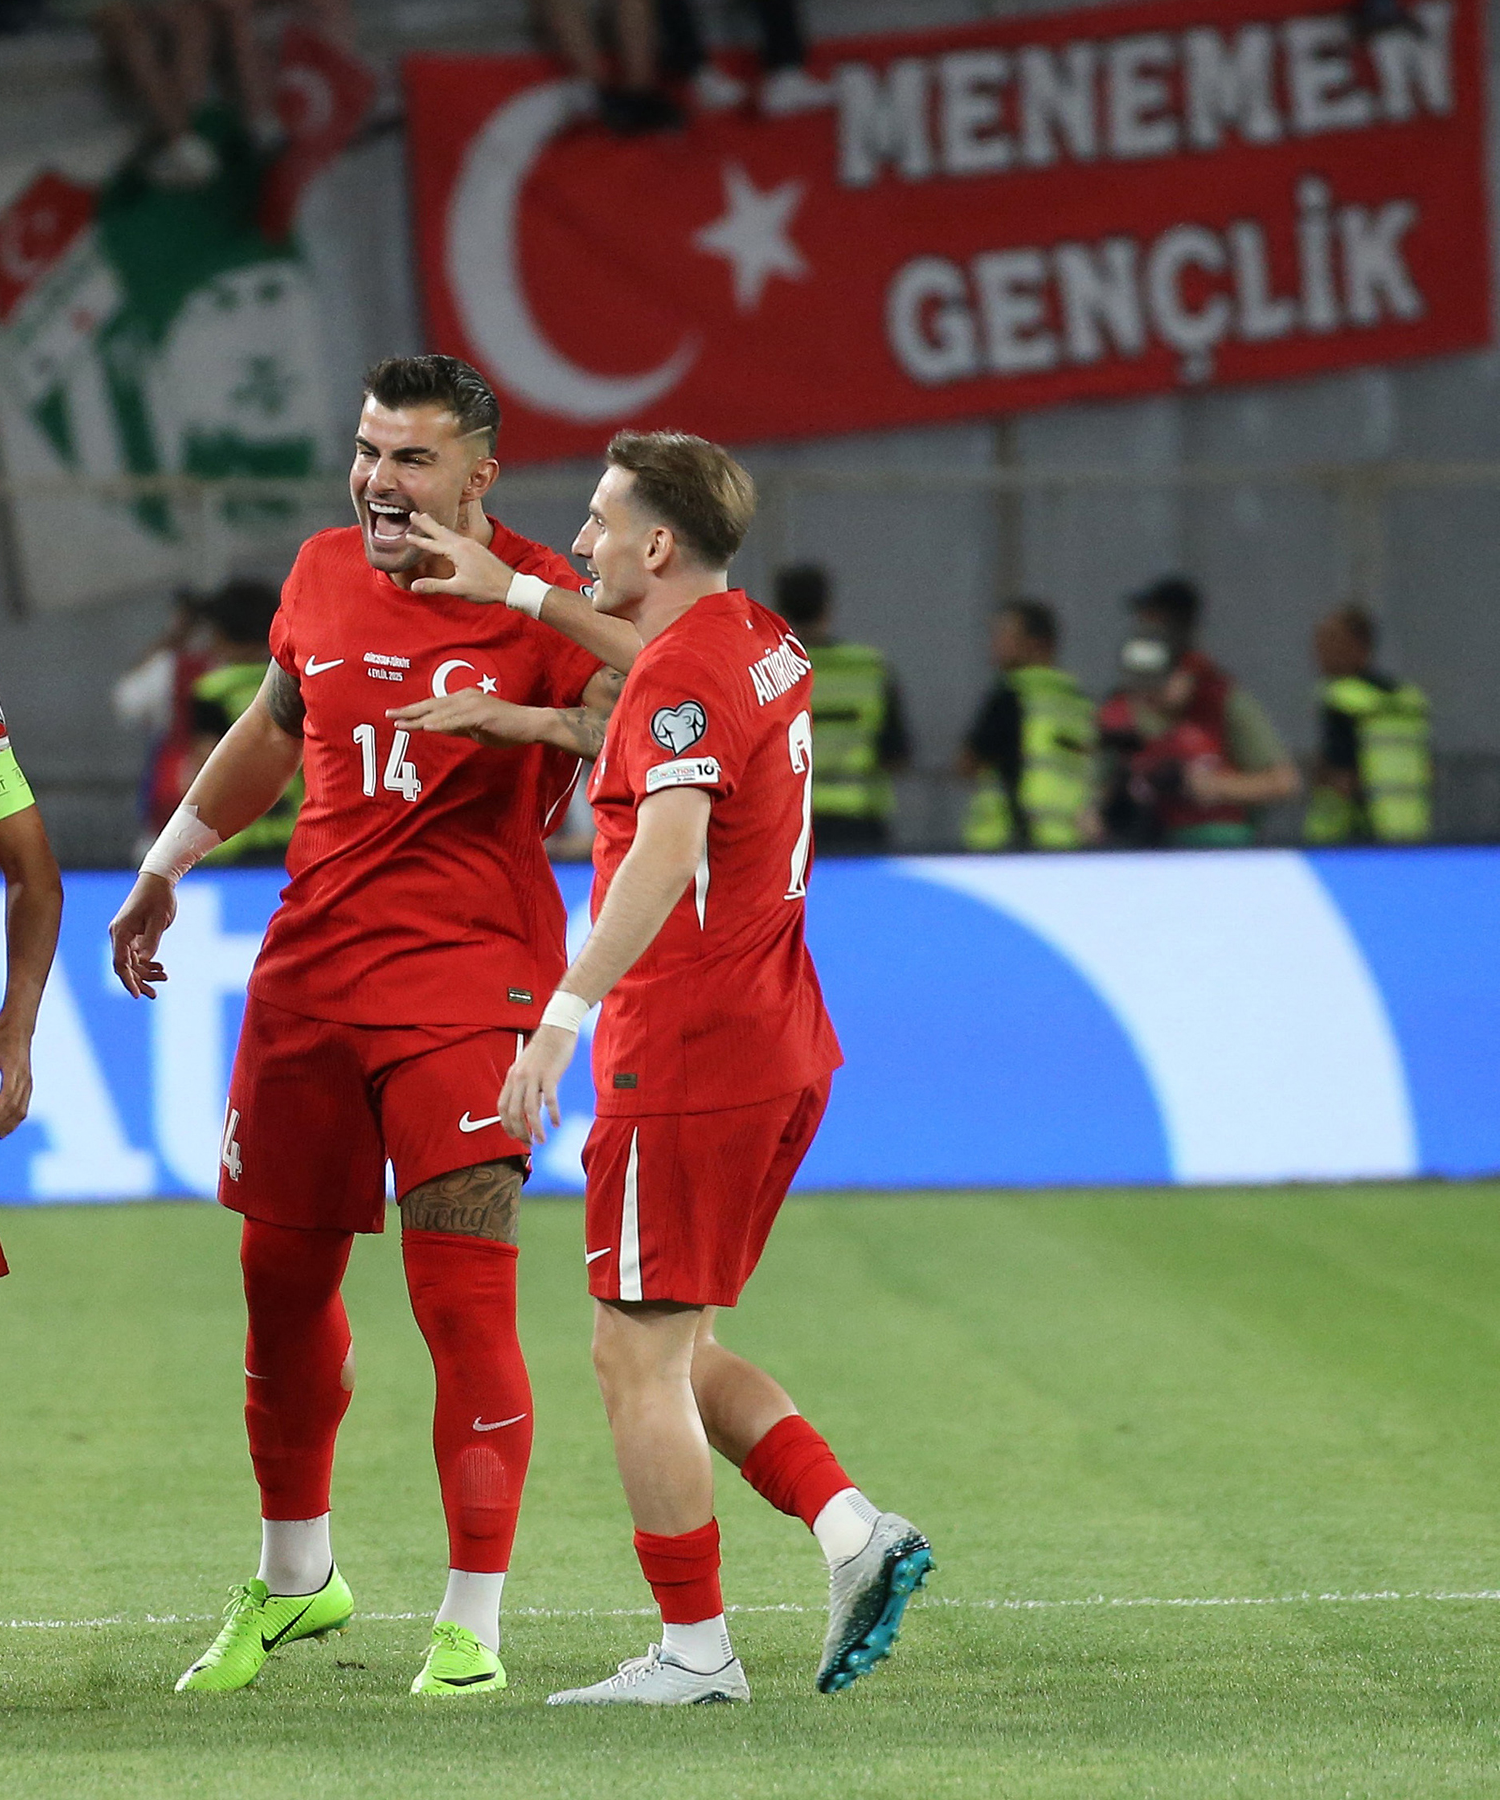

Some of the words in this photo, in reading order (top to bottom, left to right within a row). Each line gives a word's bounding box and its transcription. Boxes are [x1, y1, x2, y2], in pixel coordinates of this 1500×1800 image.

[834, 4, 1454, 187] MENEMEN
[886, 176, 1425, 382] GENÇLİK
[353, 723, 422, 802] 14
[219, 1097, 244, 1182] 4
